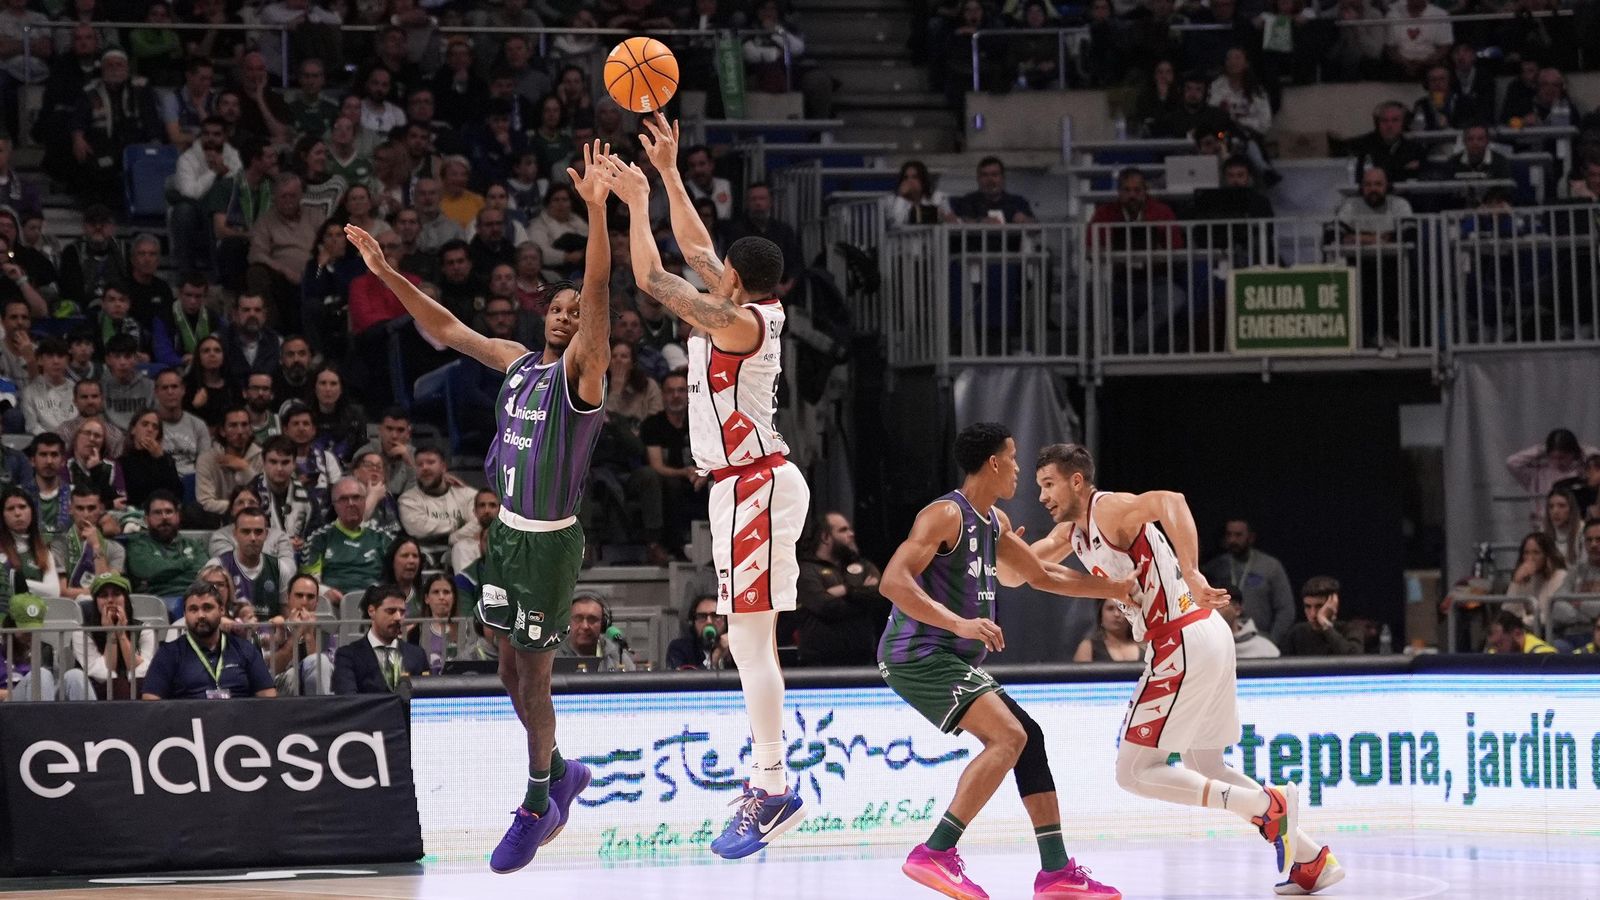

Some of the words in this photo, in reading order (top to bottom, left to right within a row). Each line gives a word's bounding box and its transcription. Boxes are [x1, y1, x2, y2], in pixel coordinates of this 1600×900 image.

[1244, 285, 1305, 310] SALIDA
[1317, 283, 1339, 308] DE
[1238, 313, 1346, 339] EMERGENCIA
[508, 395, 547, 424] Unicaja
[19, 717, 391, 799] endesa
[1223, 723, 1452, 807] tepona,
[1462, 708, 1578, 806] jardín
